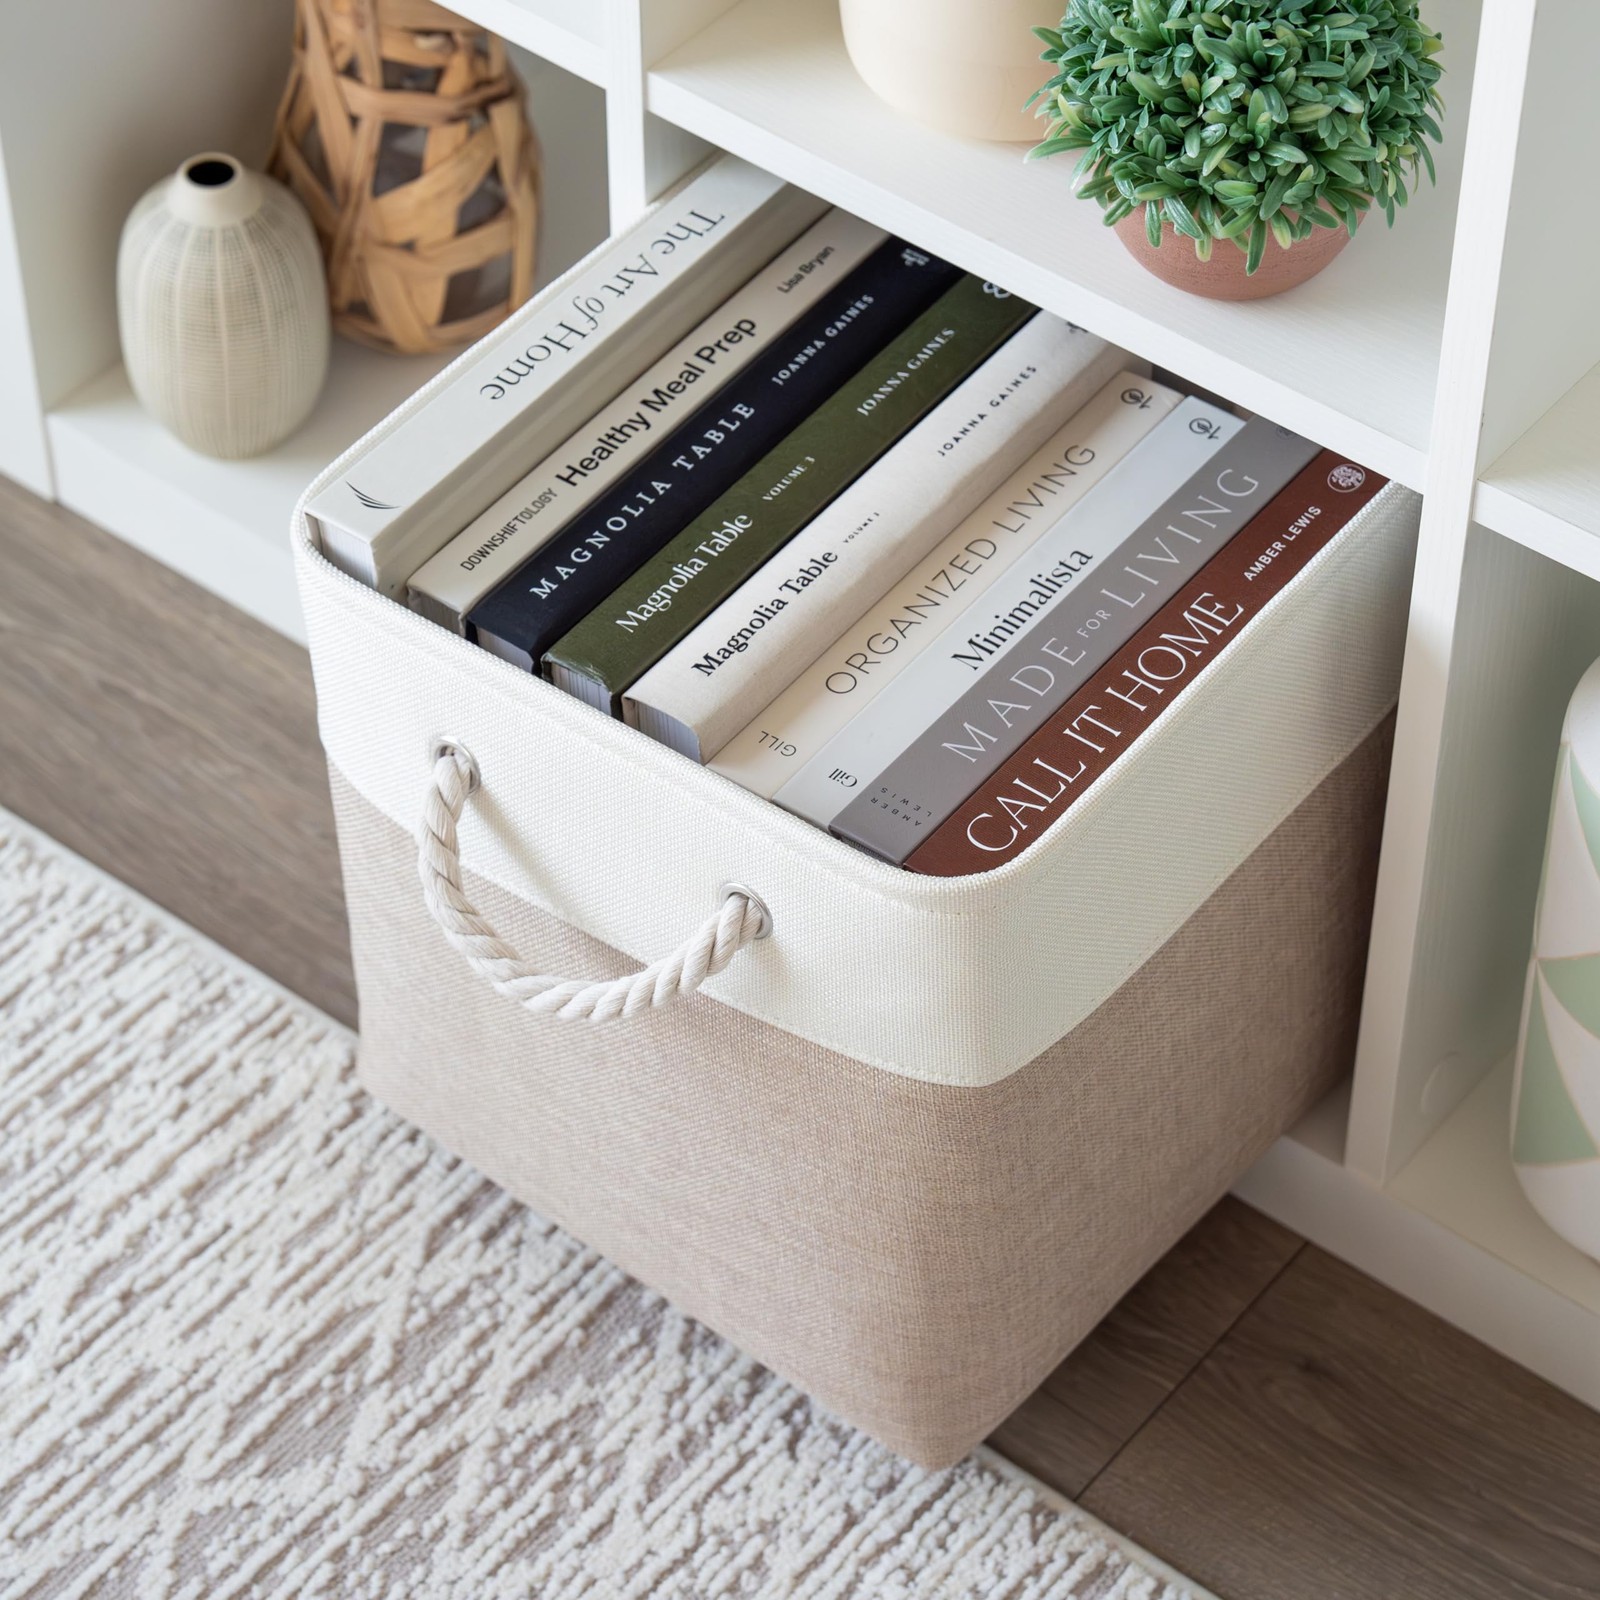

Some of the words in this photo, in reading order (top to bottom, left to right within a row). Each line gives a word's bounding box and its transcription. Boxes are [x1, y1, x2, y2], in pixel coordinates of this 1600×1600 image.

[651, 209, 725, 255] The
[776, 273, 806, 294] Lisa
[801, 245, 835, 277] Bryan
[572, 296, 605, 331] of
[600, 254, 659, 298] Art
[479, 320, 588, 400] Home
[771, 339, 826, 386] JOANNA
[824, 294, 875, 338] GAINES
[856, 371, 910, 417] JOANNA
[906, 327, 956, 371] GAINES
[460, 487, 558, 571] DOWNSHIFTOLOGY
[555, 409, 651, 487] Healthy
[639, 361, 706, 413] Meal
[694, 318, 757, 365] Prep
[936, 411, 987, 458] JOANNA
[989, 365, 1038, 408] GAINES
[529, 478, 672, 599] MAGNOLIA
[672, 402, 755, 472] TABLE
[762, 464, 807, 501] VOLUME
[825, 538, 998, 695] ORGANIZED
[992, 444, 1096, 534] LIVING
[842, 517, 874, 544] VOLUME
[1243, 540, 1287, 582] AMBER
[1282, 505, 1323, 542] LEWIS
[615, 557, 708, 634] Magnolia
[693, 512, 754, 567] Table
[951, 549, 1093, 672] Minimalista
[691, 594, 789, 677] Magnolia
[778, 550, 839, 604] Table
[941, 637, 1087, 763] MADE
[1076, 608, 1113, 640] FOR
[1100, 468, 1259, 609] LIVING
[758, 730, 798, 758] GILL
[966, 757, 1087, 851] CALL
[1062, 704, 1122, 754] IT
[1104, 592, 1244, 712] HOME
[828, 768, 858, 788] Gill
[870, 797, 923, 827] AMBER
[880, 787, 932, 818] LEWIS
